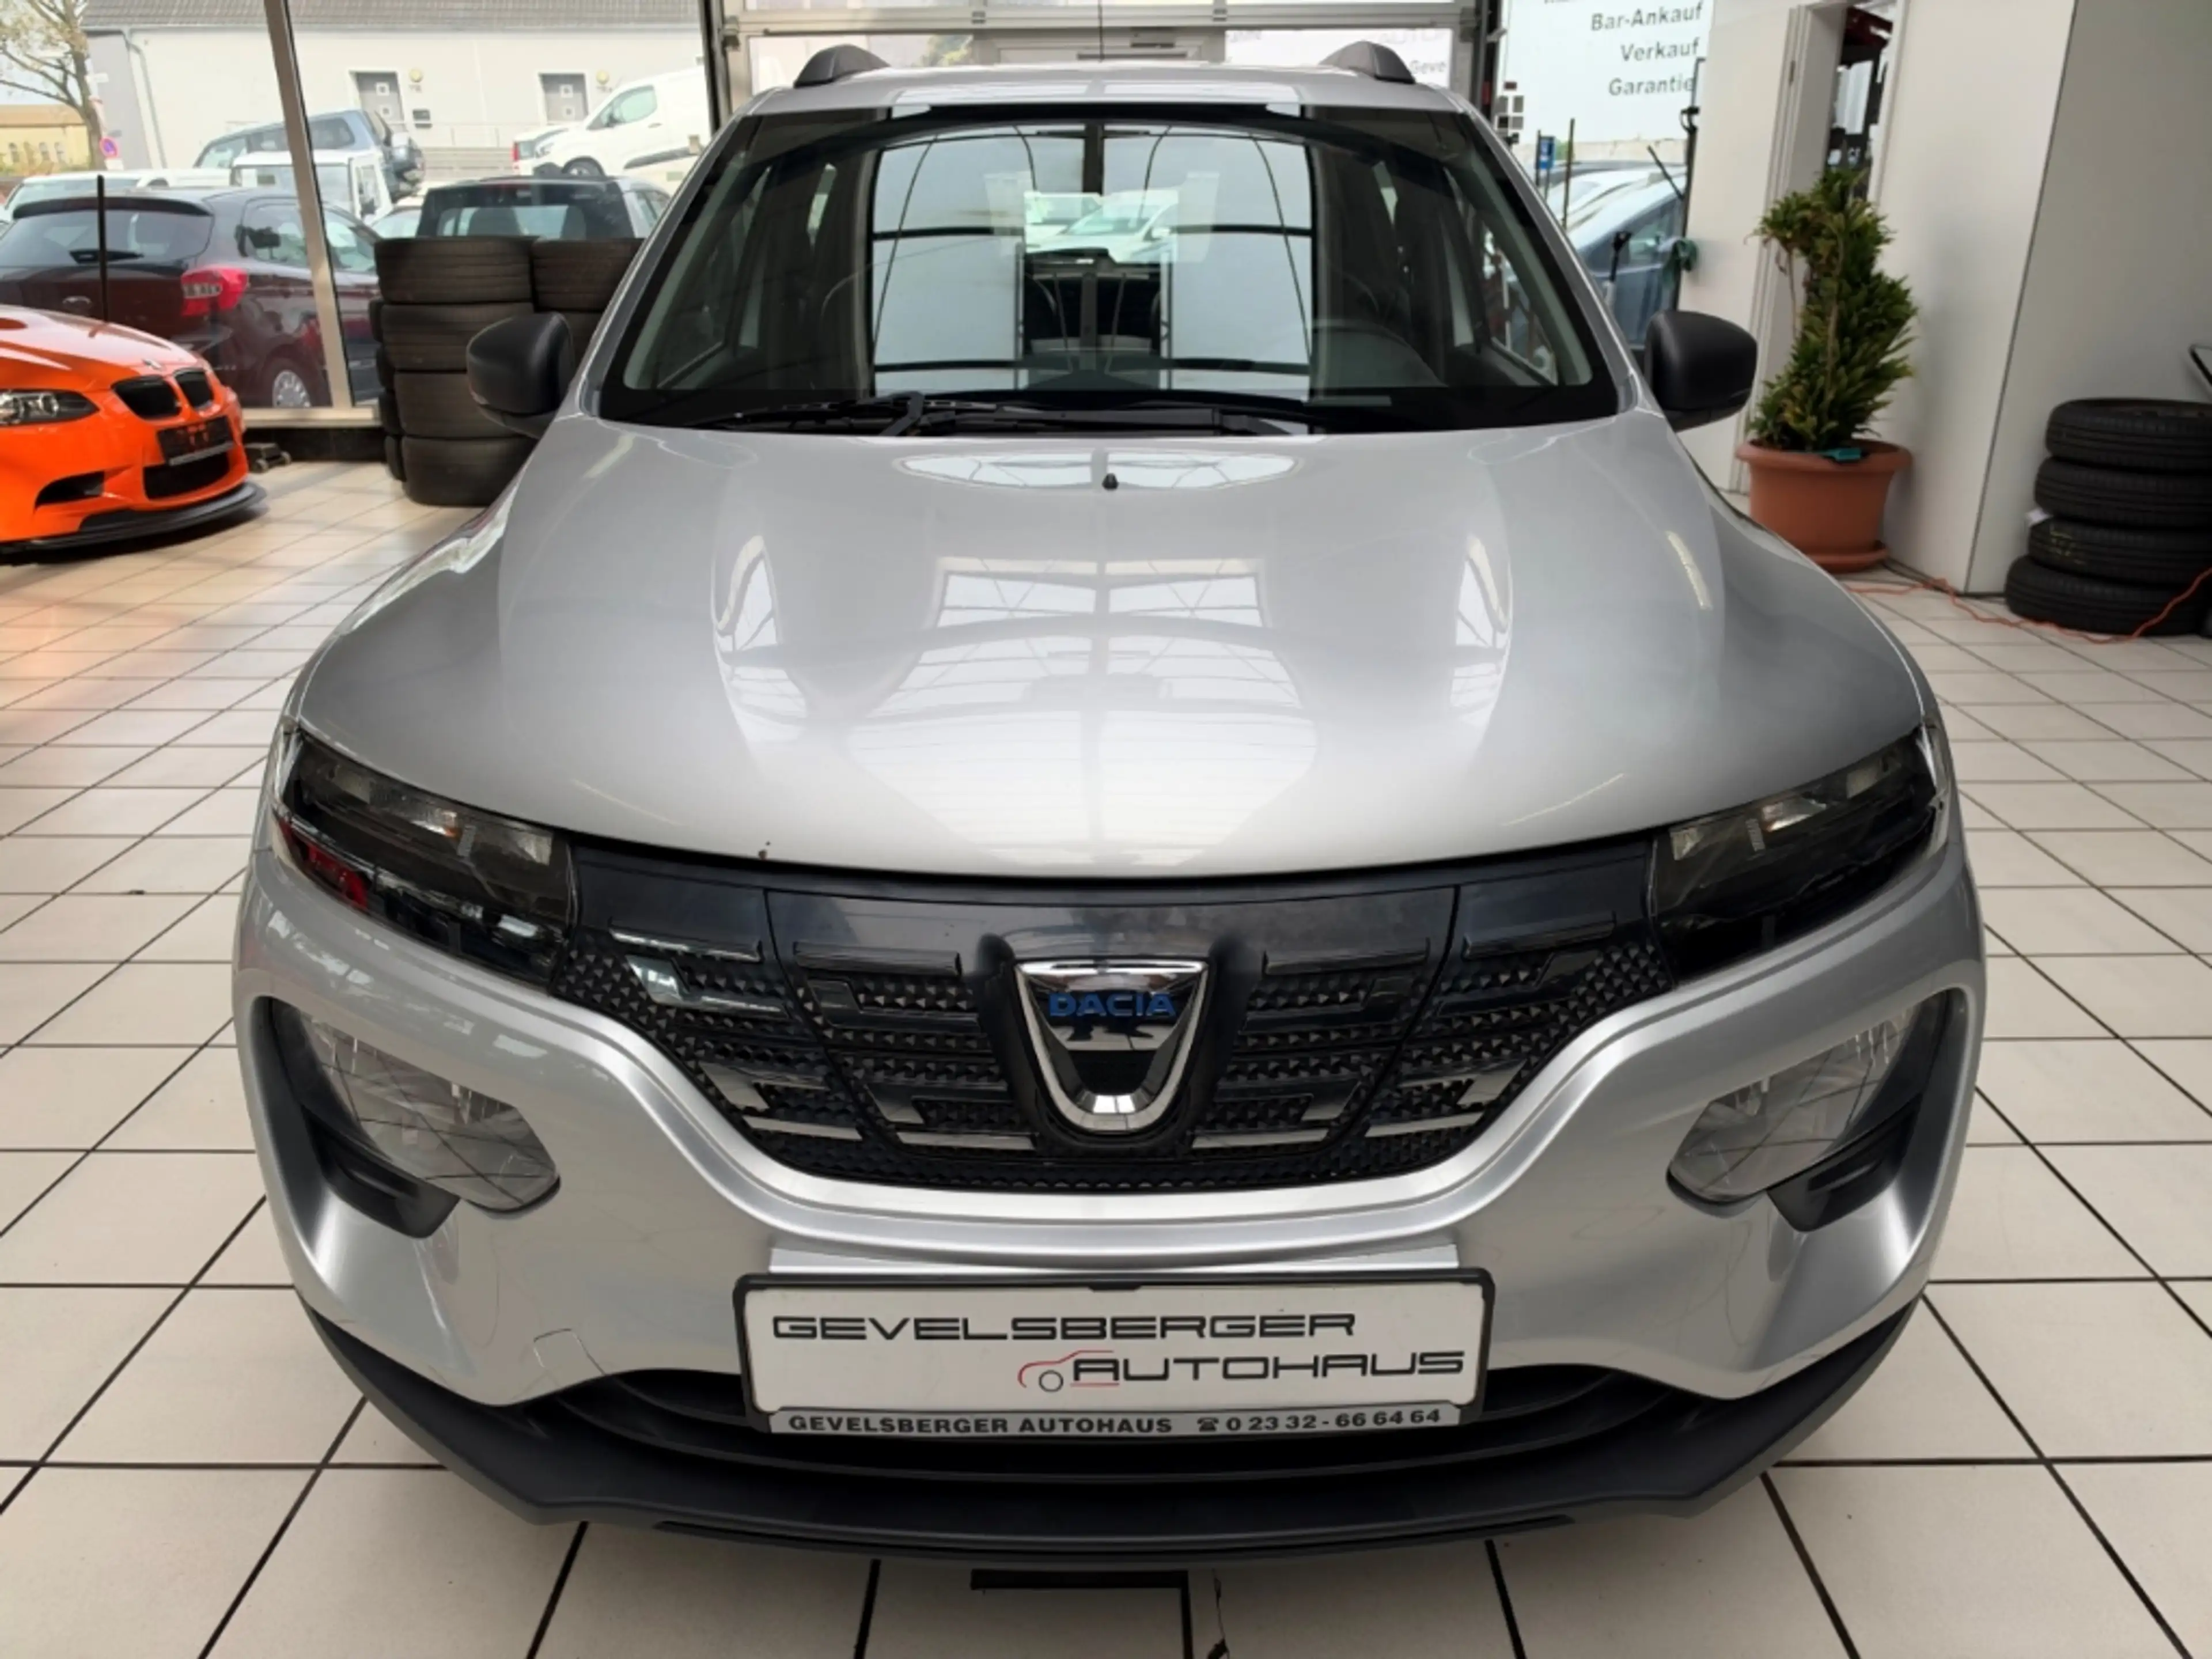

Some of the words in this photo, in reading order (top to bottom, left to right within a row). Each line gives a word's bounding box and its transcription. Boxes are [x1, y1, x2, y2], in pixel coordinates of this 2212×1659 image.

[1591, 0, 1703, 31] Bar-Ankauf
[1620, 36, 1699, 61] Verkauf
[1608, 74, 1694, 96] Garantie
[1048, 993, 1176, 1016] DACIA
[772, 1314, 1355, 1340] GEVELSBERGER
[1073, 1351, 1464, 1382] AUTOHAUS
[789, 1416, 1009, 1434] GEVELSBERGER
[1019, 1418, 1172, 1433] AUTOHAUS
